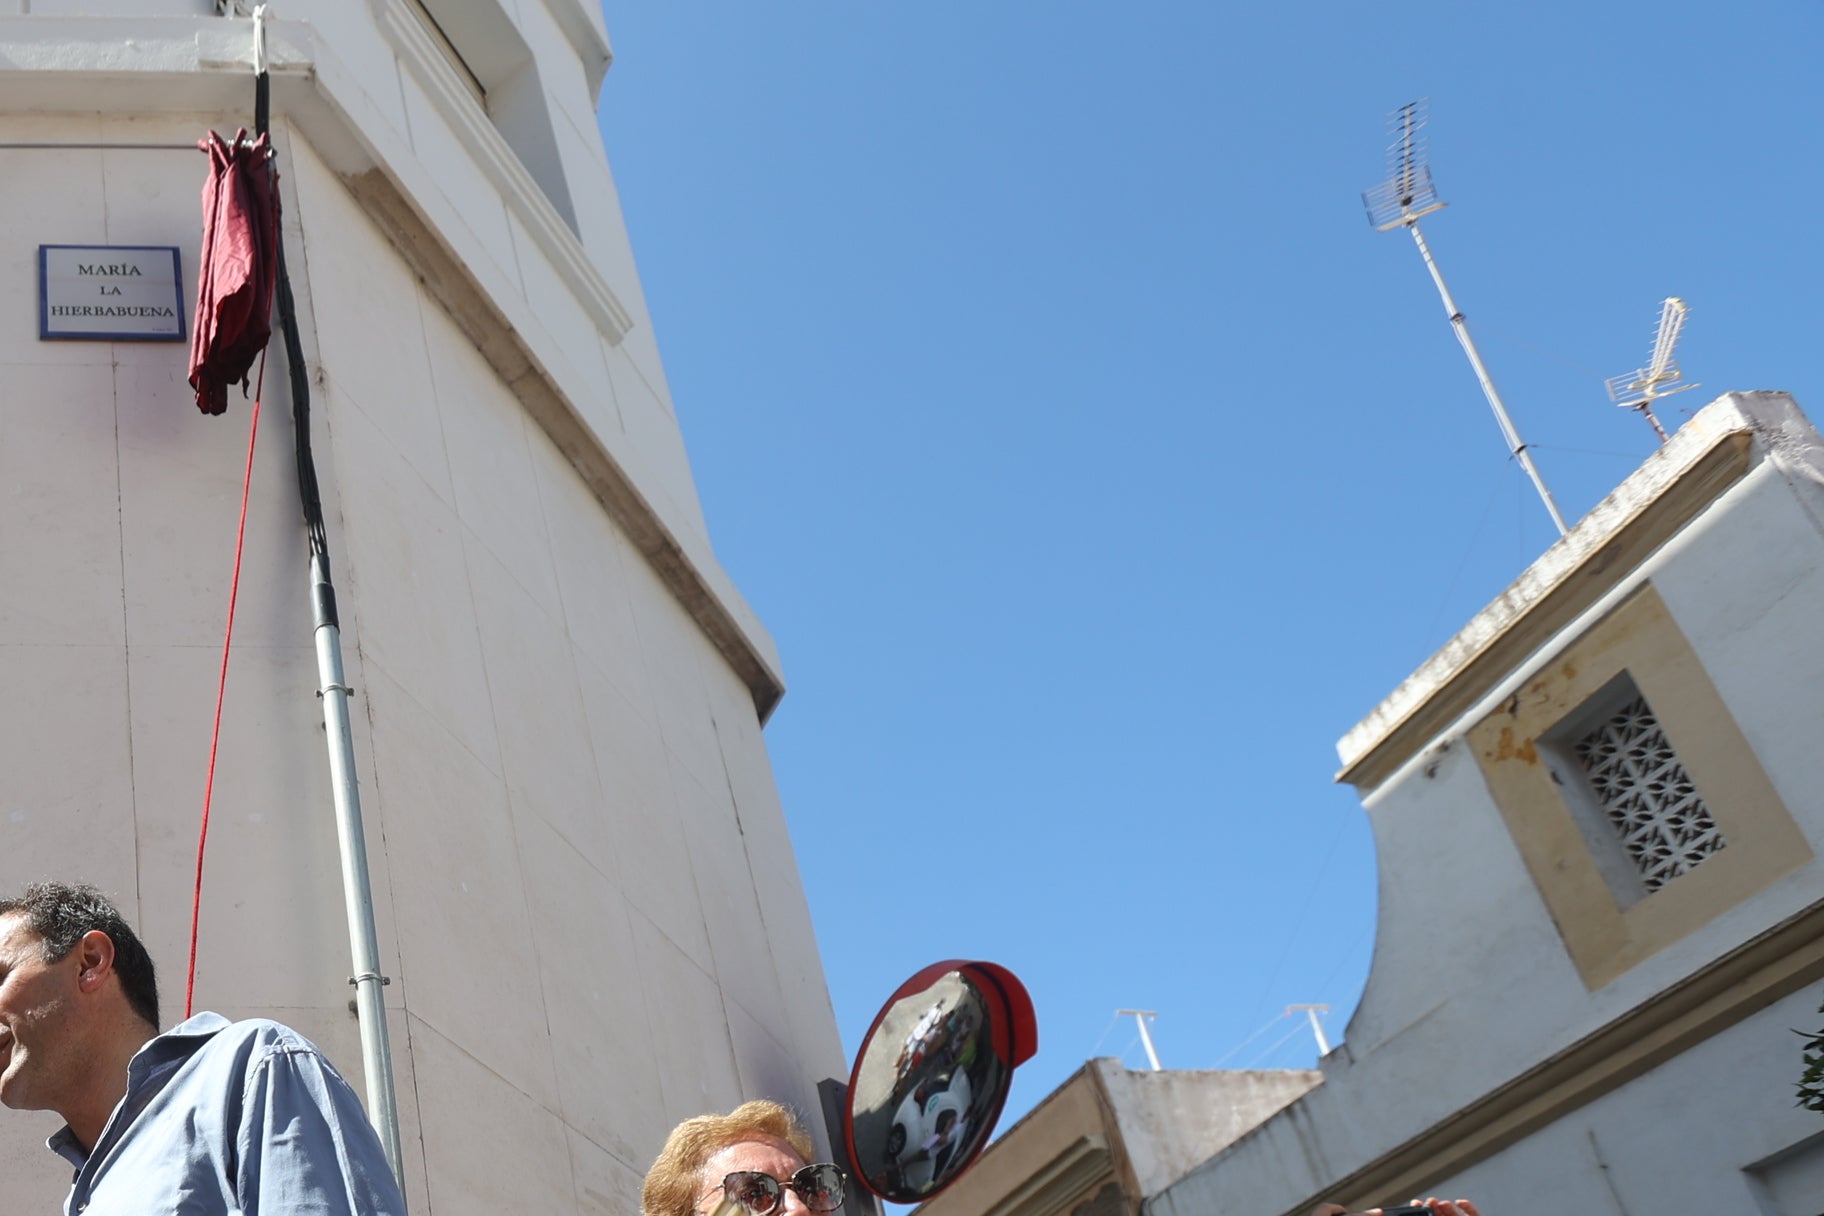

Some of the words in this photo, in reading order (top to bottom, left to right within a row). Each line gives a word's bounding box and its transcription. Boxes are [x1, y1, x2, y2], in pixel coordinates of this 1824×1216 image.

[78, 262, 142, 276] MARÍA
[100, 286, 122, 296] LA
[51, 306, 174, 317] HIERBABUENA
